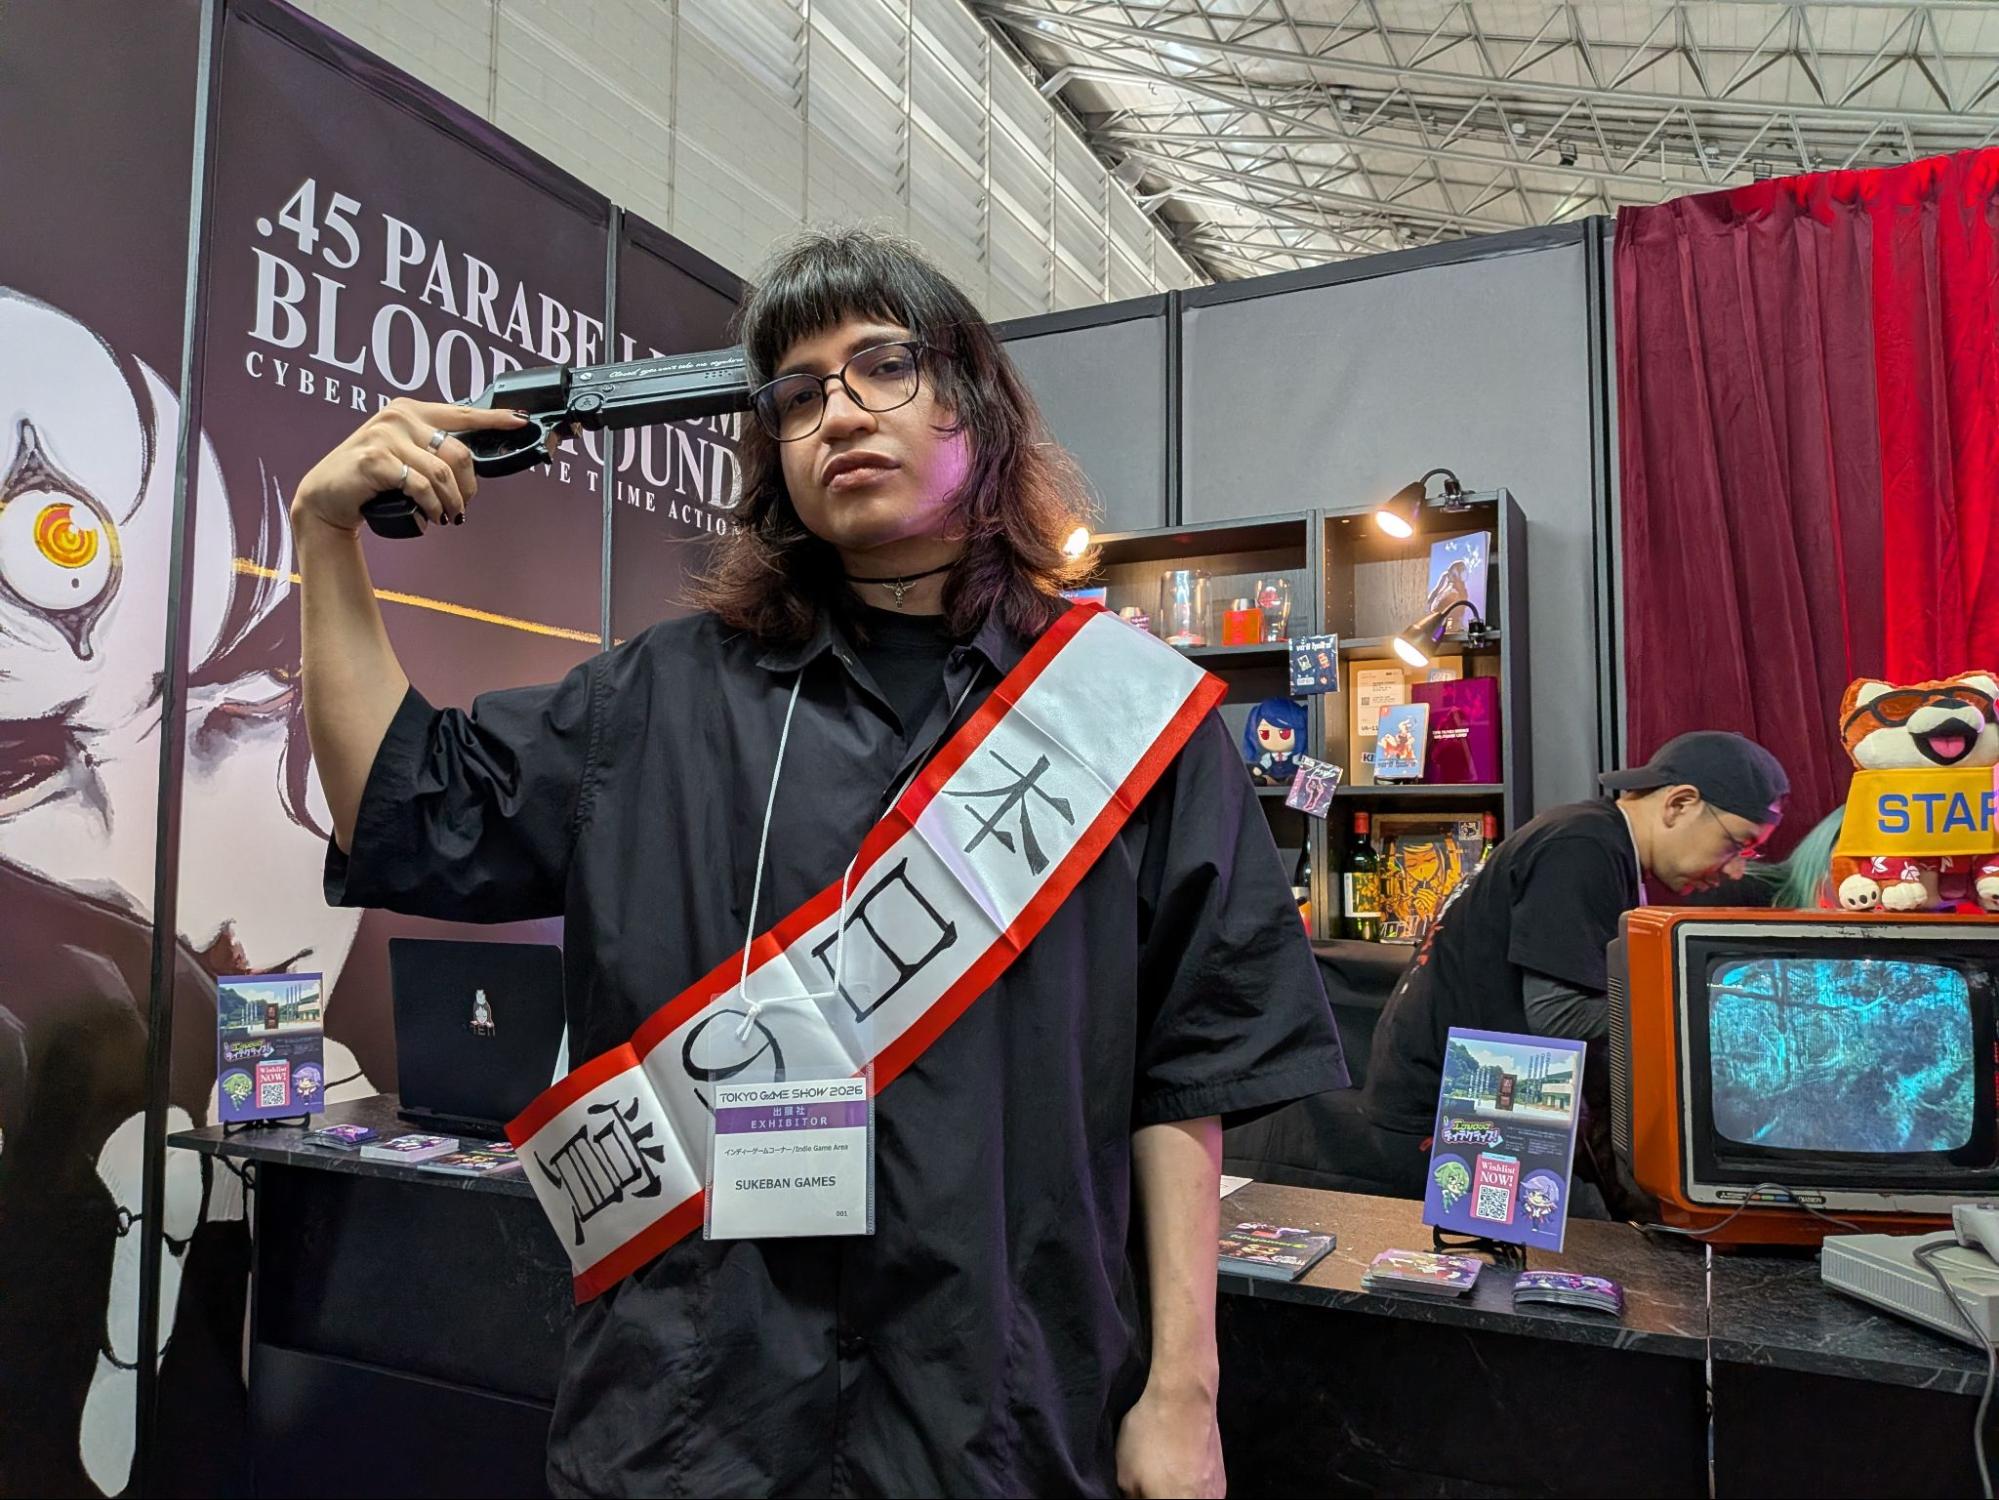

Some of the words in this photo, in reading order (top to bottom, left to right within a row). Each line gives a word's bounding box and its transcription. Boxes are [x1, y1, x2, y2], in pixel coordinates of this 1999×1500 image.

[256, 178, 361, 268] .45
[586, 471, 656, 512] TIME
[719, 1092, 758, 1103] TOKYO
[760, 1089, 790, 1101] GAME
[792, 1087, 829, 1099] SHOW
[829, 1085, 864, 1096] 2026
[773, 1105, 806, 1117] 出展社
[751, 1116, 828, 1129] EXHIBITOR
[813, 1144, 832, 1152] Game
[833, 1143, 849, 1151] Area
[1481, 1161, 1515, 1174] Wishlist
[735, 1178, 791, 1191] SUKEBAN
[794, 1176, 836, 1188] GAMES
[1479, 1171, 1514, 1187] NOW!
